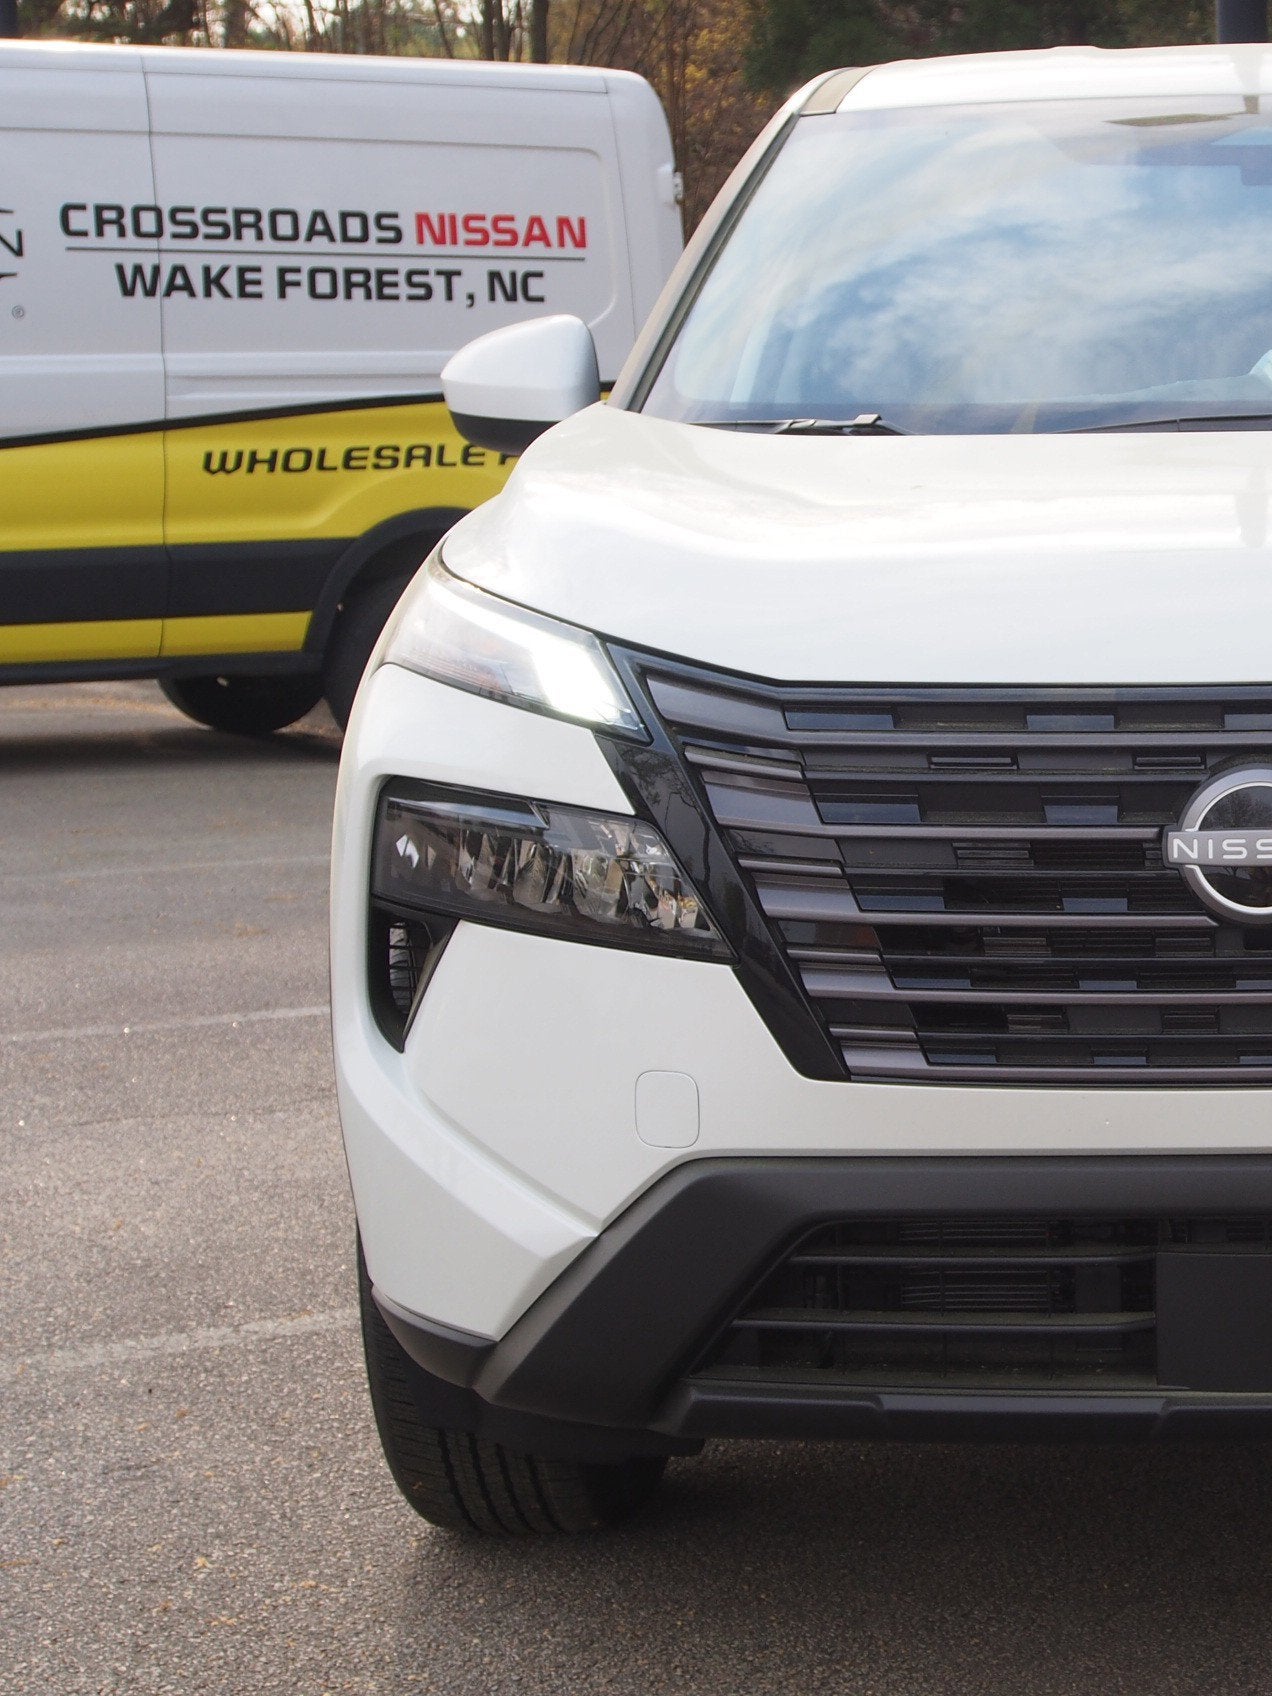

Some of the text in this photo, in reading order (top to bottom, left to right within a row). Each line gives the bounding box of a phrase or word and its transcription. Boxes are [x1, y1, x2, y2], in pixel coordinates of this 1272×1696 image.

[60, 202, 403, 244] CROSSROADS
[414, 211, 587, 249] NISSAN
[114, 262, 263, 299] WAKE
[487, 269, 546, 303] NC
[202, 442, 486, 476] WHOLESALE
